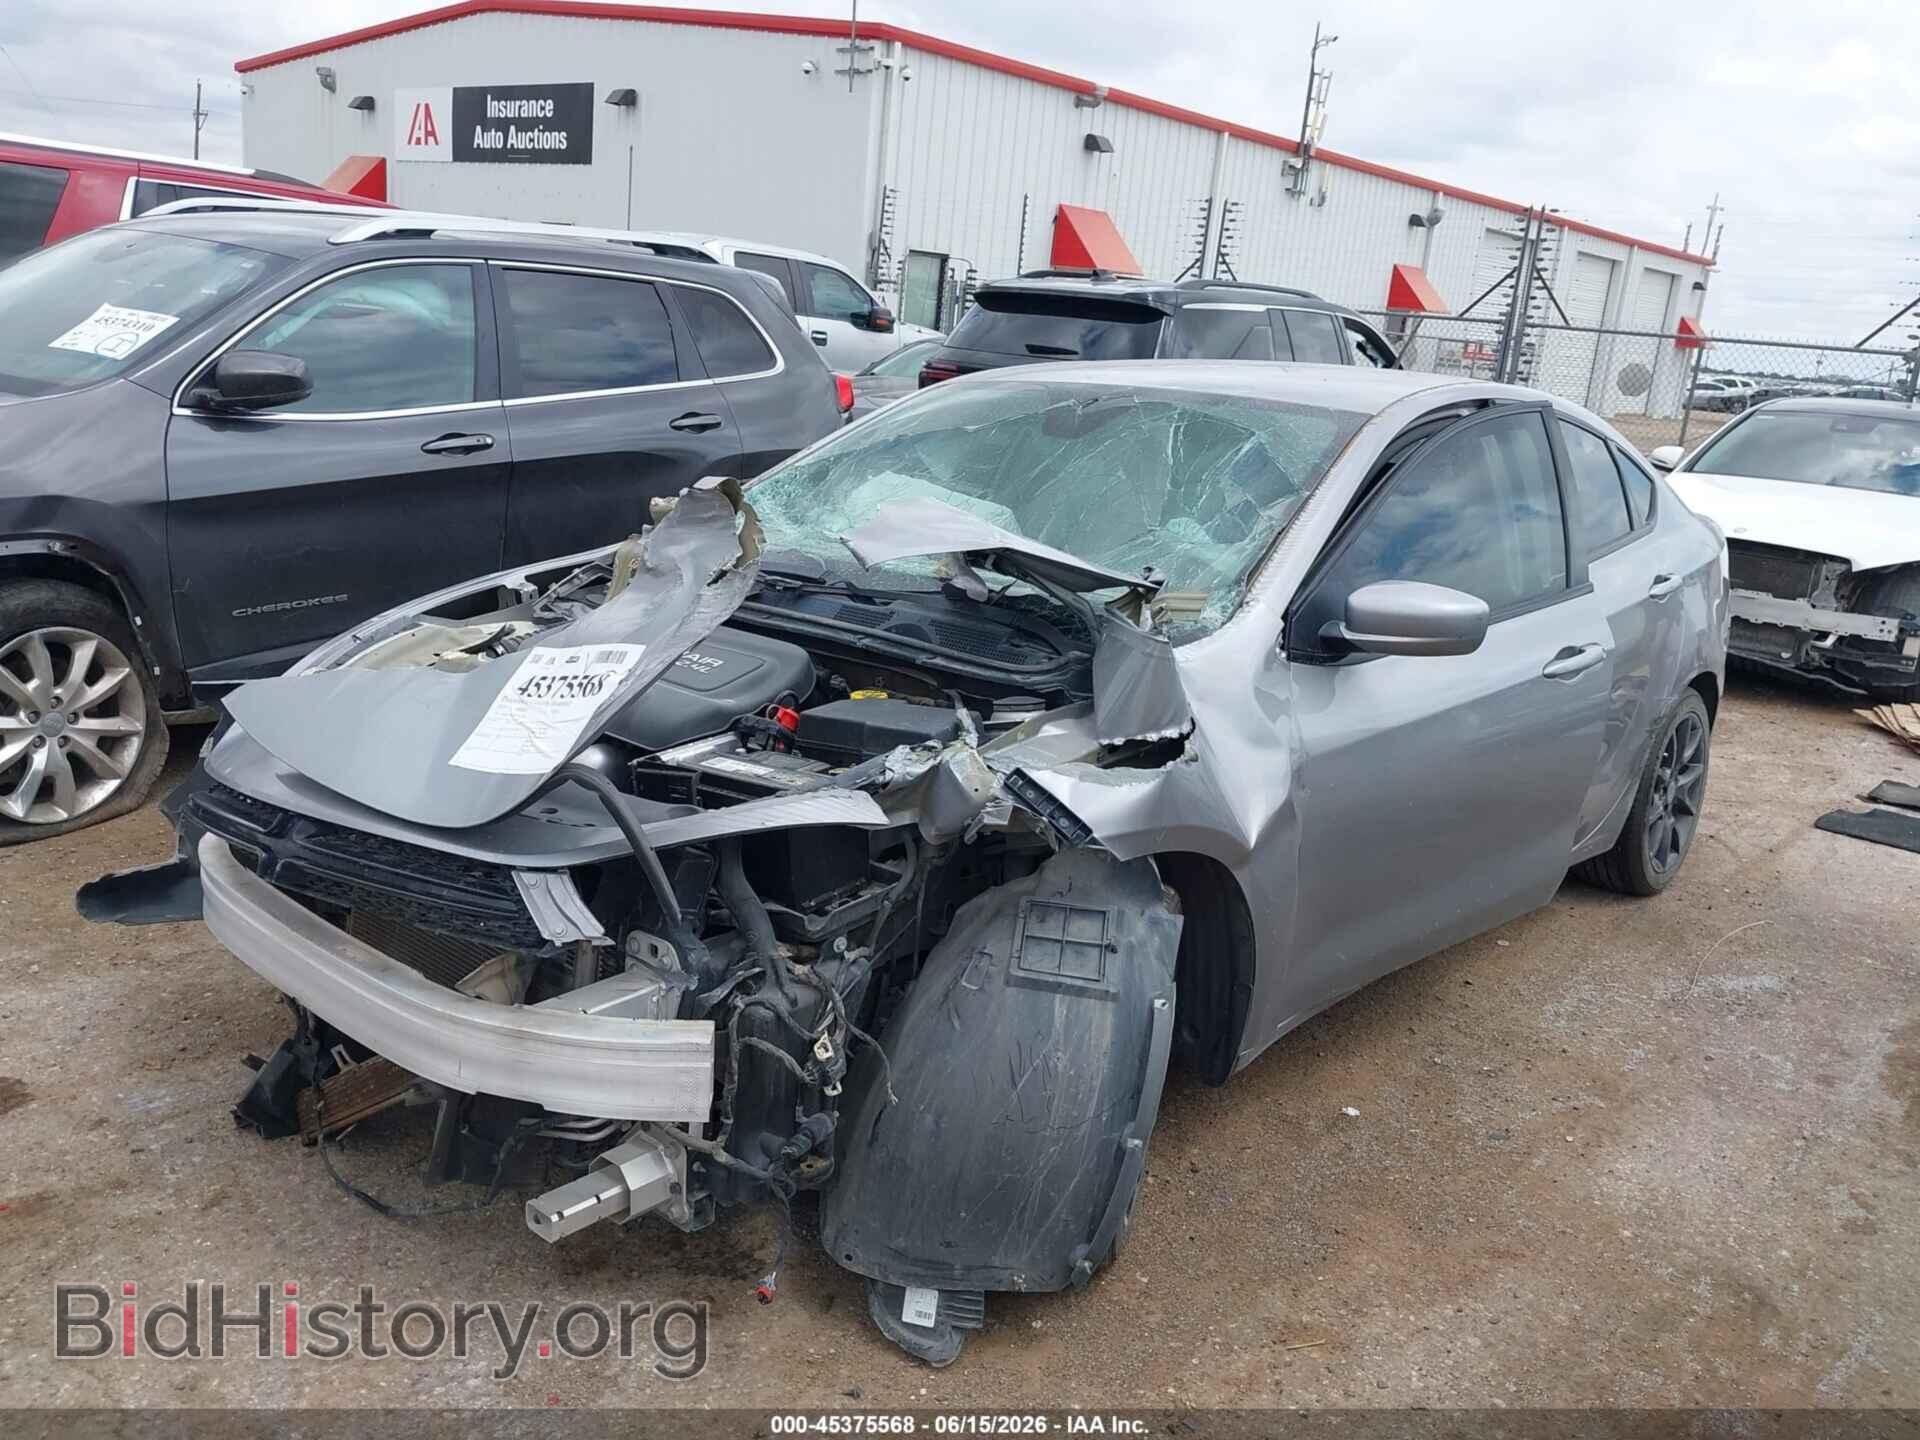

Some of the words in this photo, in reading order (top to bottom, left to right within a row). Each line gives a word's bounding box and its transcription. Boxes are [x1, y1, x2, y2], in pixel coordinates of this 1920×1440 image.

[487, 95, 554, 118] Insurance
[473, 125, 504, 149] Auto
[507, 124, 568, 150] Auctions
[231, 594, 348, 617] CHEROKEE
[518, 672, 609, 698] 45375568
